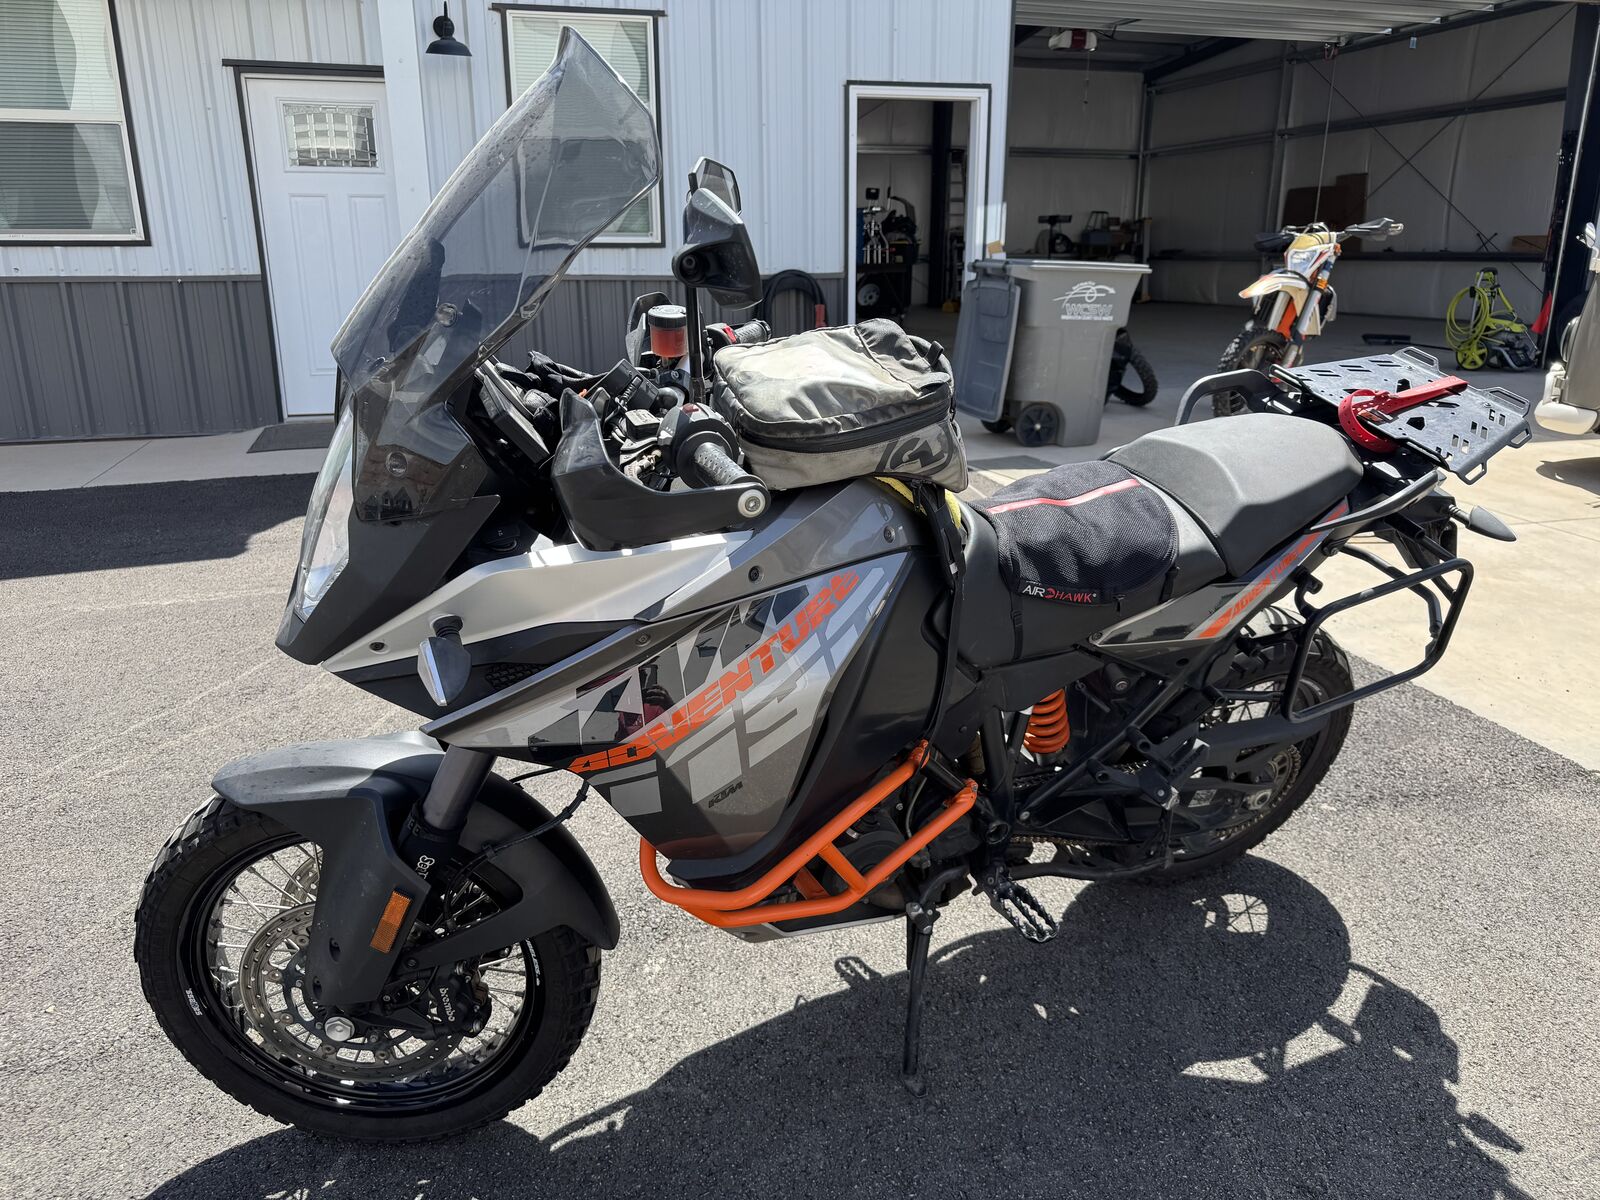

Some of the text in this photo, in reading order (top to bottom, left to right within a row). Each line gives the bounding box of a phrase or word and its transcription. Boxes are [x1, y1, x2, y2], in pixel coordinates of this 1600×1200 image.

[566, 570, 860, 774] ADVENTURE
[708, 781, 743, 808] KTM
[439, 987, 456, 1022] brembo
